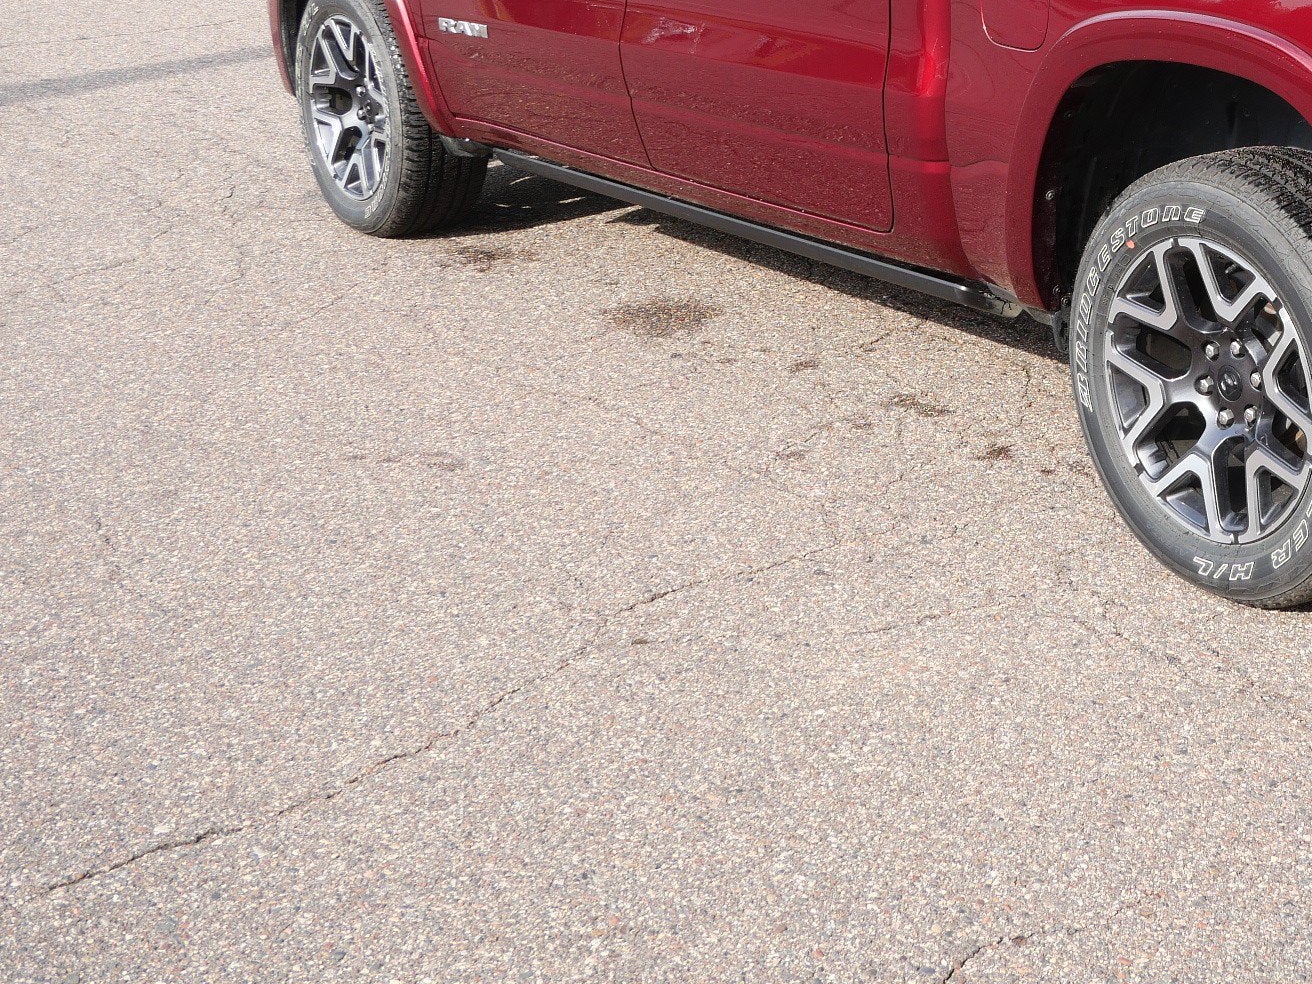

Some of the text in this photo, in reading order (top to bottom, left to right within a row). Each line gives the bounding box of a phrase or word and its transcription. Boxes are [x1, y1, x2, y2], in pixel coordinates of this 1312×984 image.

[438, 17, 489, 38] RAM
[1076, 205, 1205, 412] BRIDGESTONE
[1193, 556, 1254, 581] H/L
